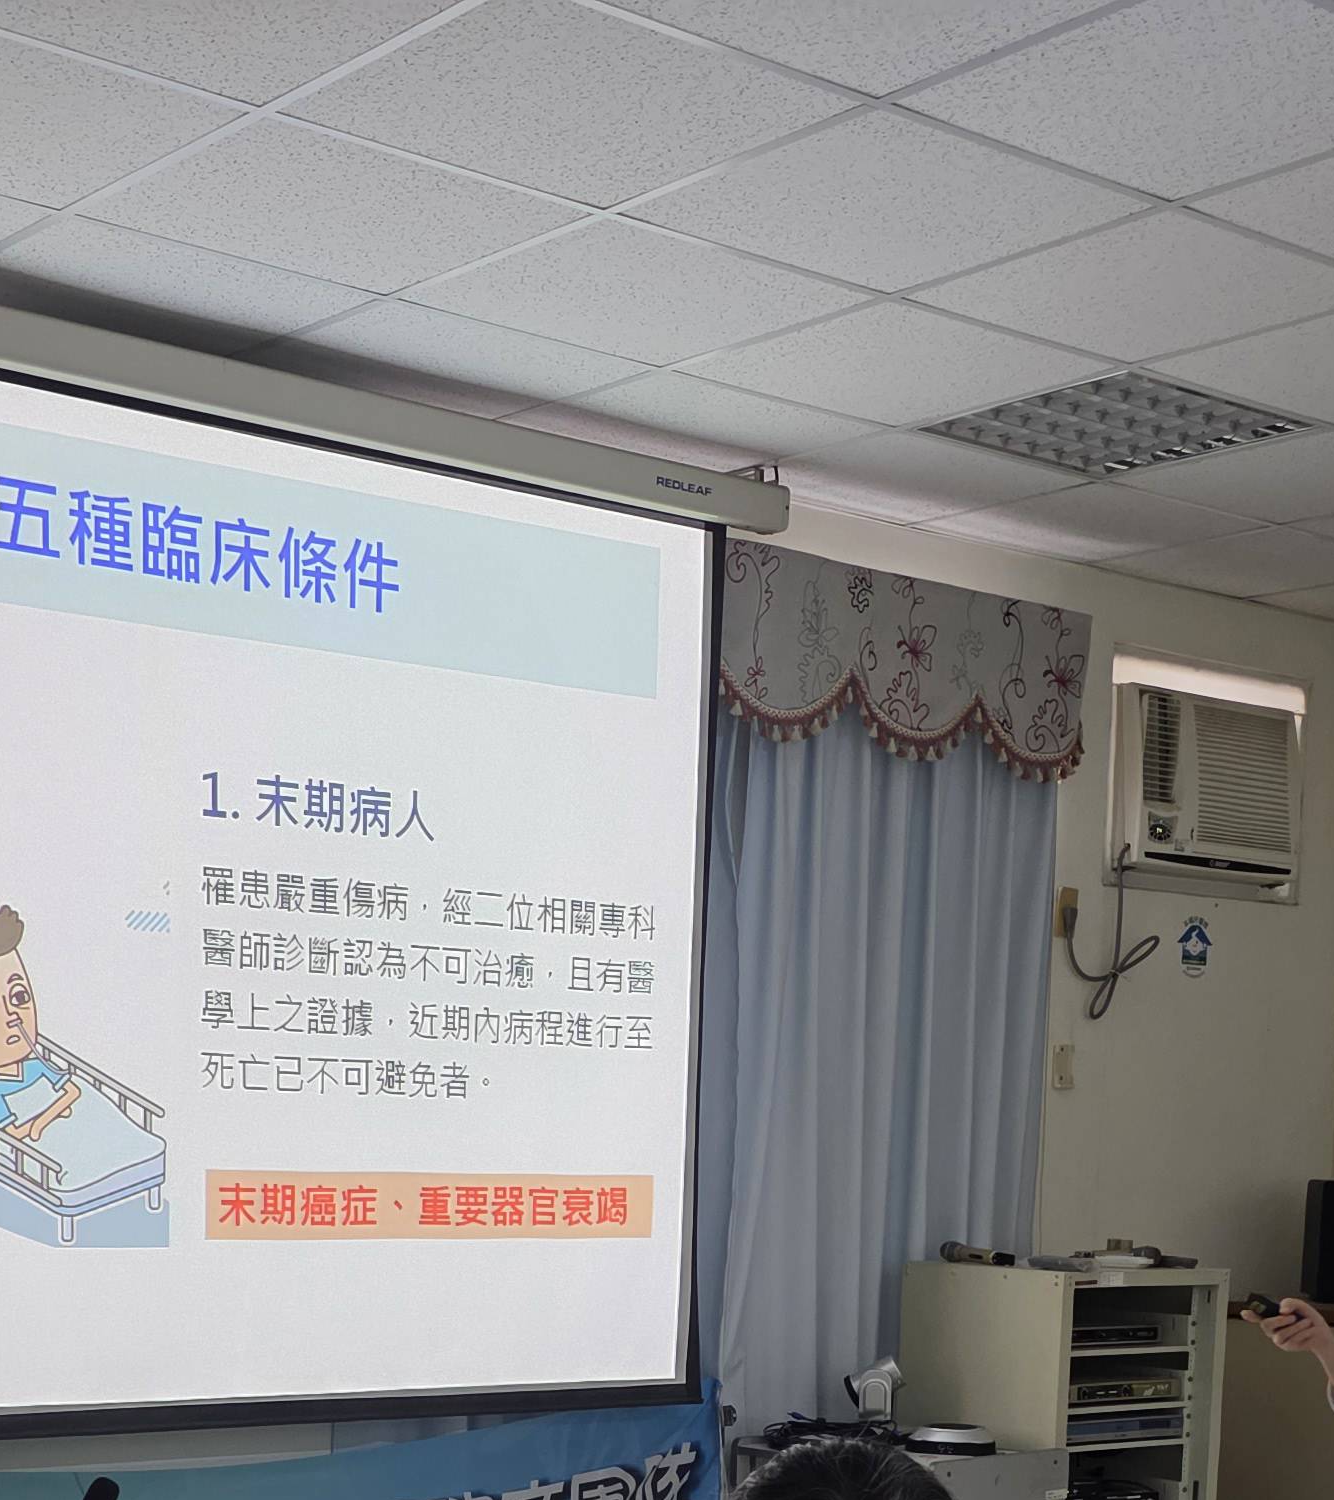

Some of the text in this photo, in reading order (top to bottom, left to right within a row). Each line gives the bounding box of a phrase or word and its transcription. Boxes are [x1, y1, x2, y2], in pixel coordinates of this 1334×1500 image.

[656, 476, 713, 496] REDLEAF
[200, 771, 436, 842] 1. 末期病人
[200, 1051, 491, 1099] 死亡已不可避免者。
[218, 1182, 629, 1227] 末期癌症、重要器官衰竭
